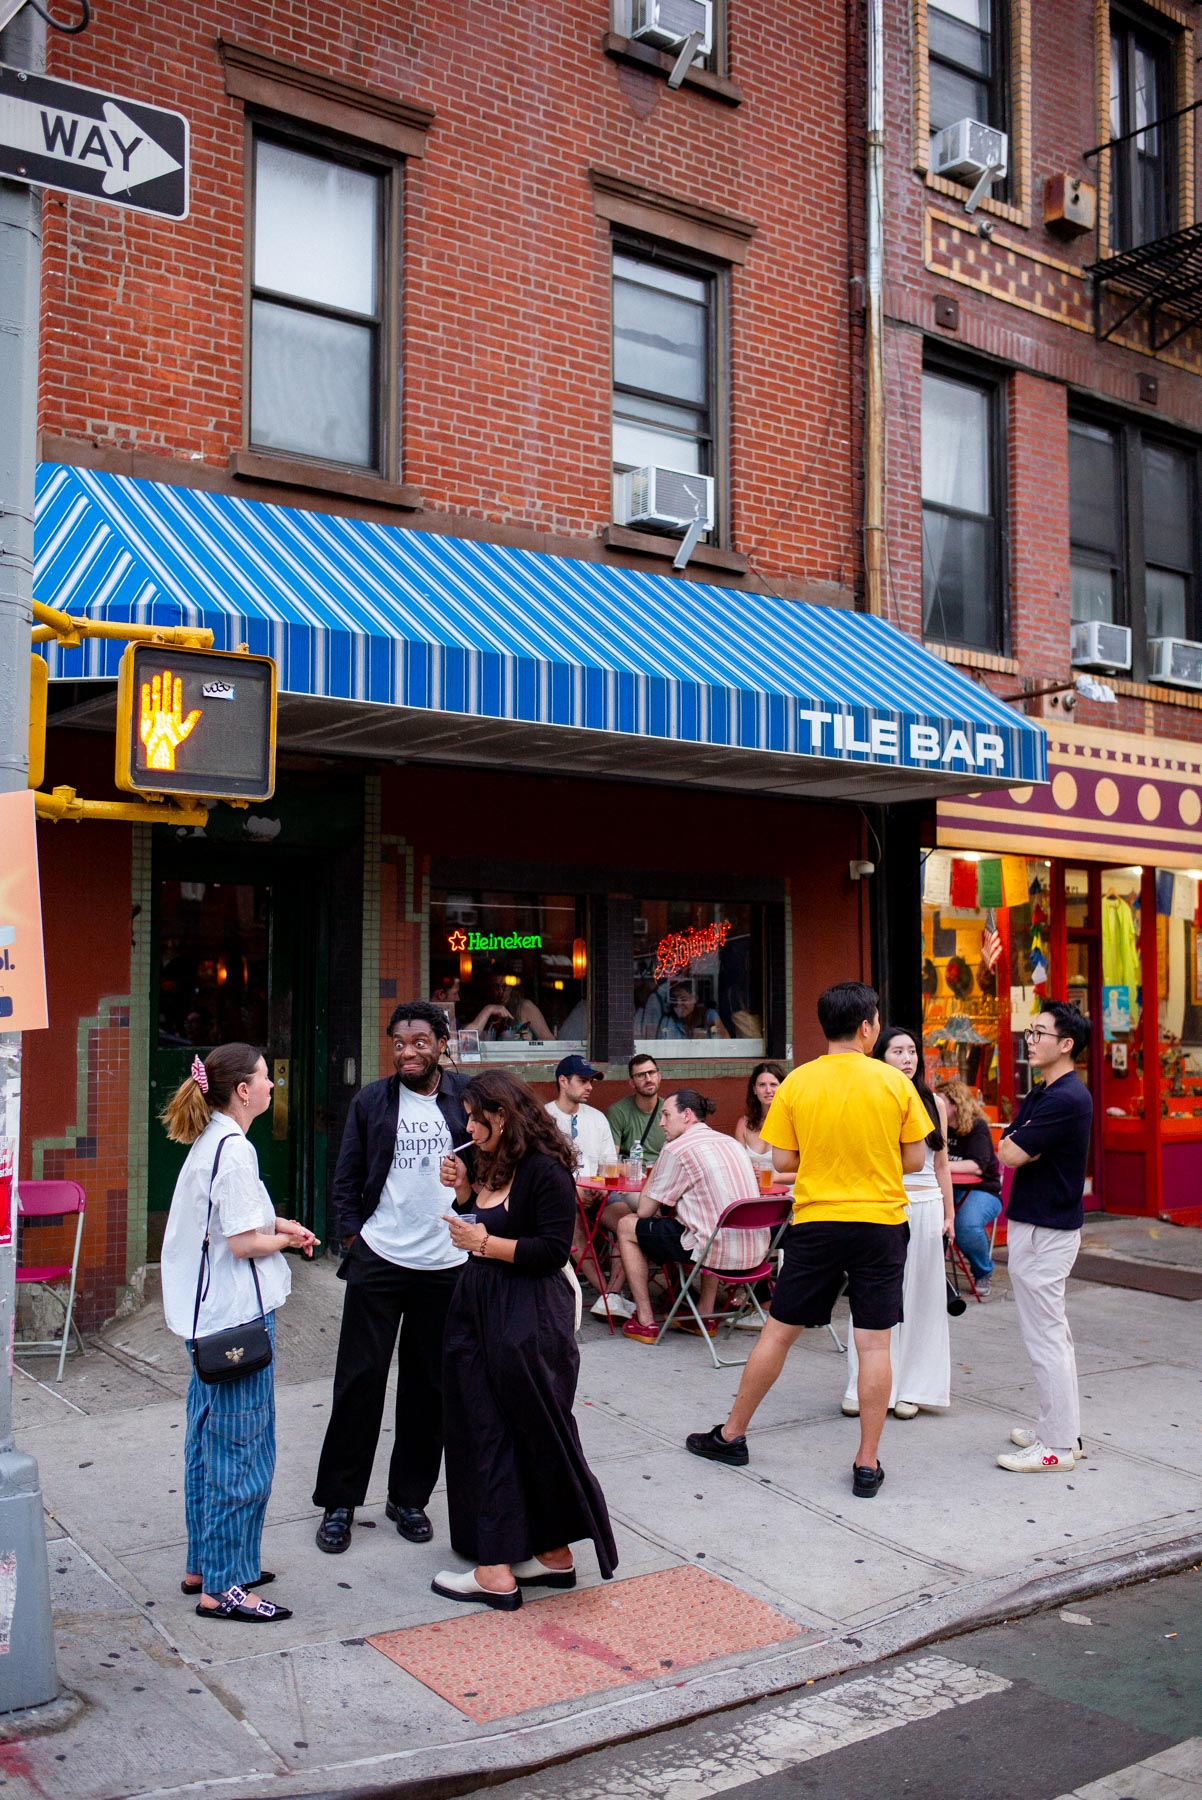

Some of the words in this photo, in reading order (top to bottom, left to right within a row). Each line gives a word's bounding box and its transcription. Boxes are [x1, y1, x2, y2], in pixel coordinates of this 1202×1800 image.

[40, 111, 144, 172] WAY
[800, 709, 900, 757] TILE
[909, 724, 1005, 769] BAR
[467, 931, 542, 950] Heineken
[397, 1118, 429, 1133] Are
[396, 1137, 448, 1155] happy
[393, 1152, 416, 1169] for
